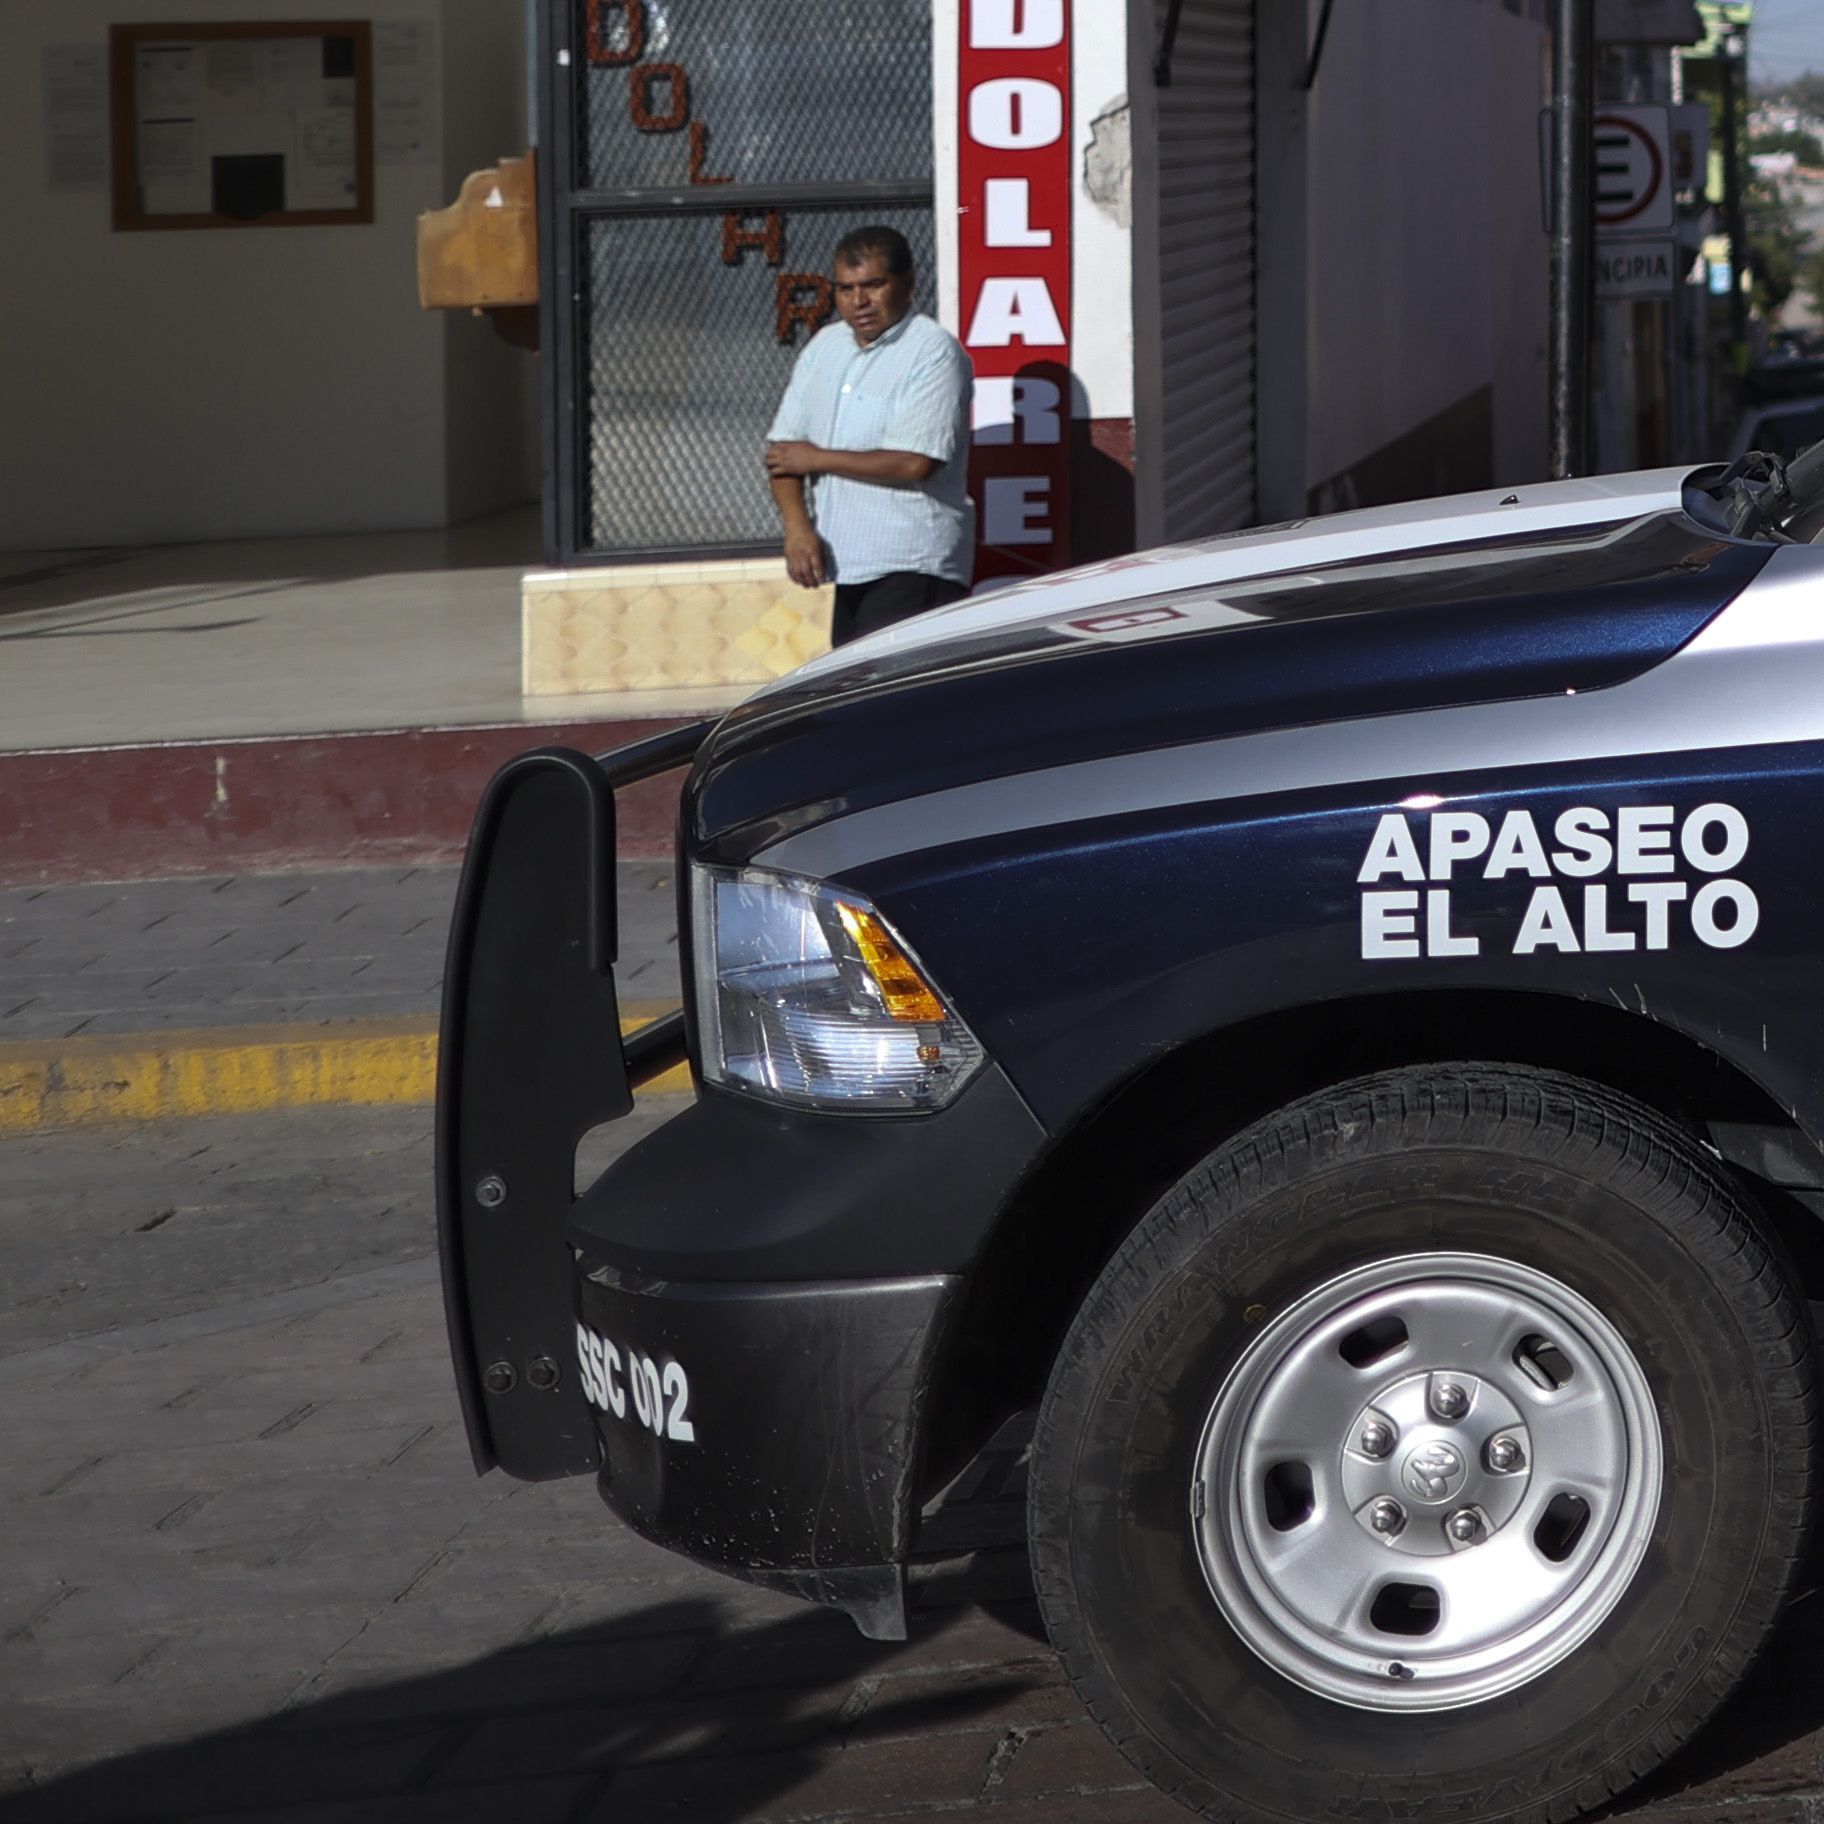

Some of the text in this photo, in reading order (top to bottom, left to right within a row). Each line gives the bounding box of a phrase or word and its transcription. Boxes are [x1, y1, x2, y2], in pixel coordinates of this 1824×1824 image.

[1597, 254, 1668, 283] NCIPIA
[1356, 802, 1750, 883] APASEO
[1361, 878, 1760, 960] EL ALTO
[576, 1322, 695, 1443] SSC 002
